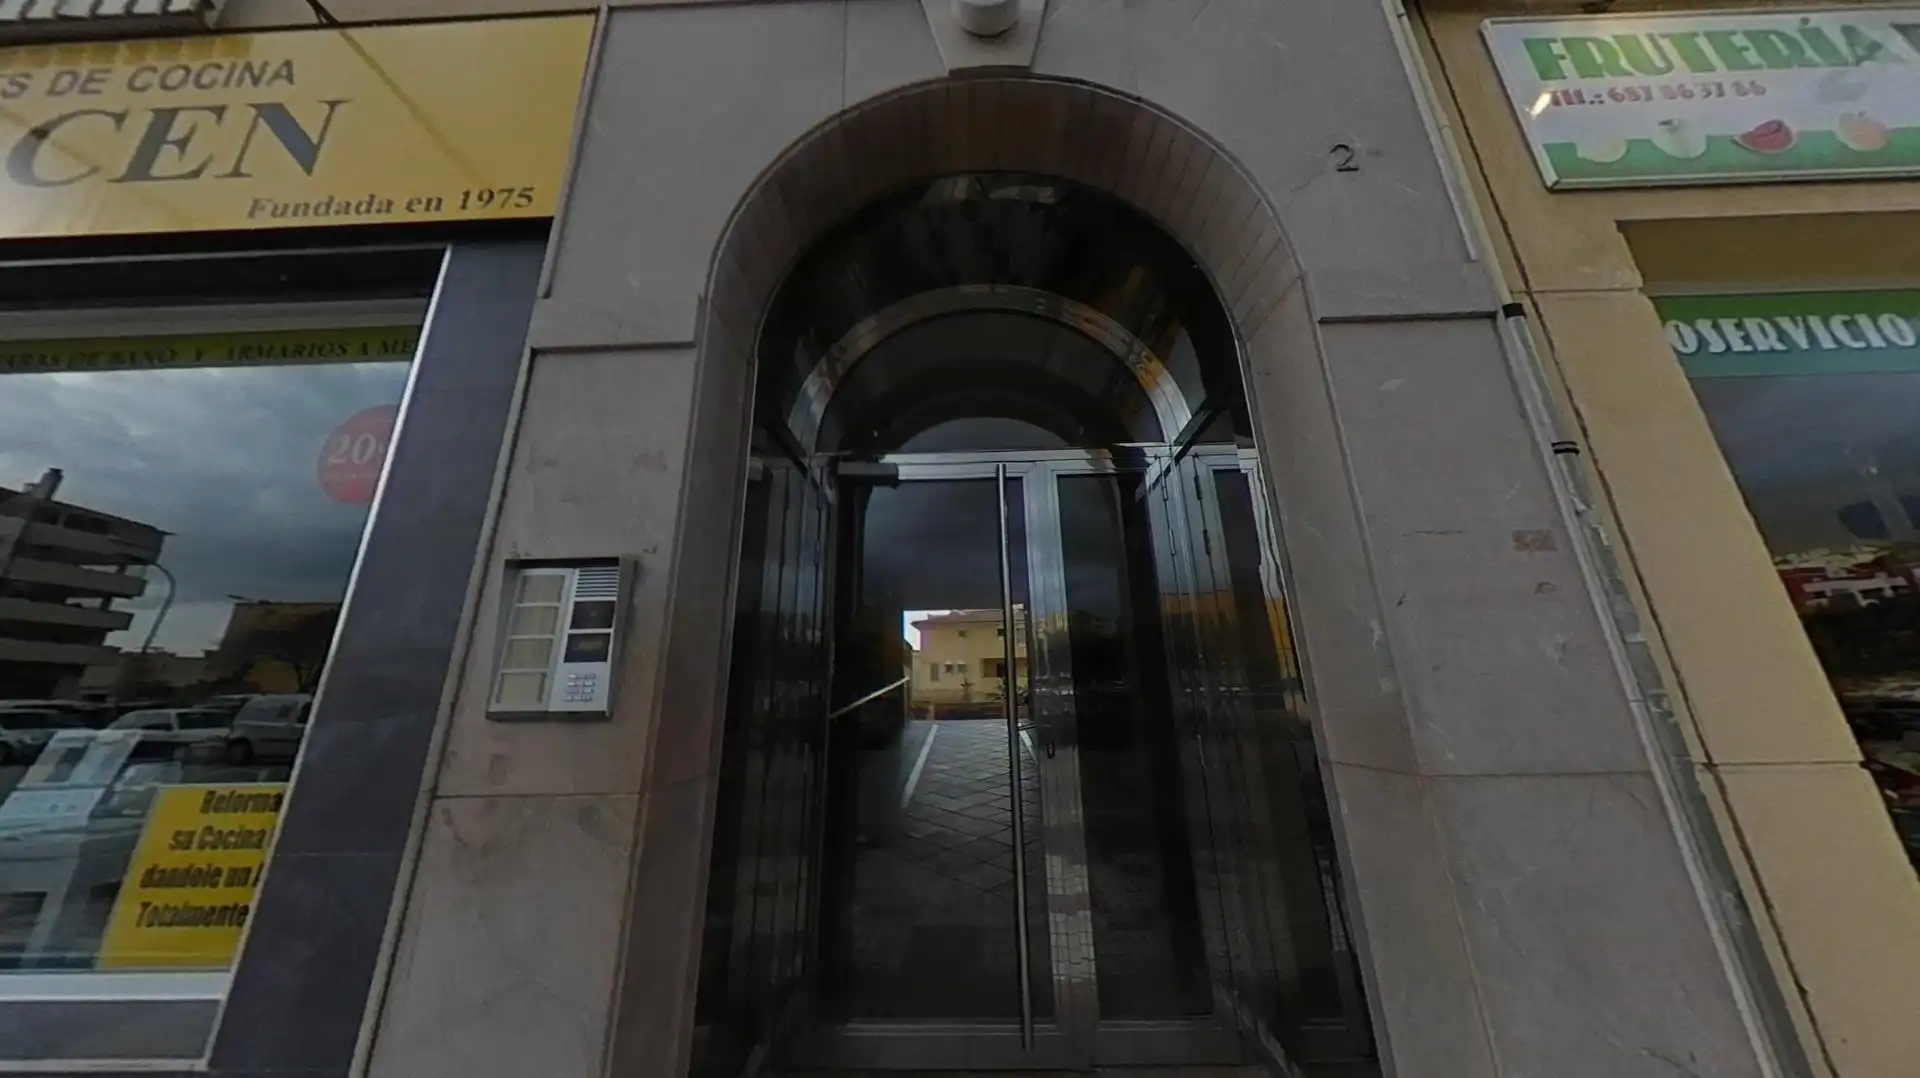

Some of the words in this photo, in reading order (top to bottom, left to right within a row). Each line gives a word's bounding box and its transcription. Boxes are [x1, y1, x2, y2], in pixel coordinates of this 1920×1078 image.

[46, 68, 111, 96] DE
[126, 59, 296, 94] COCINA
[5, 99, 352, 188] CEN
[1328, 143, 1360, 173] 2
[246, 194, 393, 220] Fundada
[405, 195, 443, 213] en
[459, 186, 536, 211] 1975
[198, 825, 267, 850] Cocina
